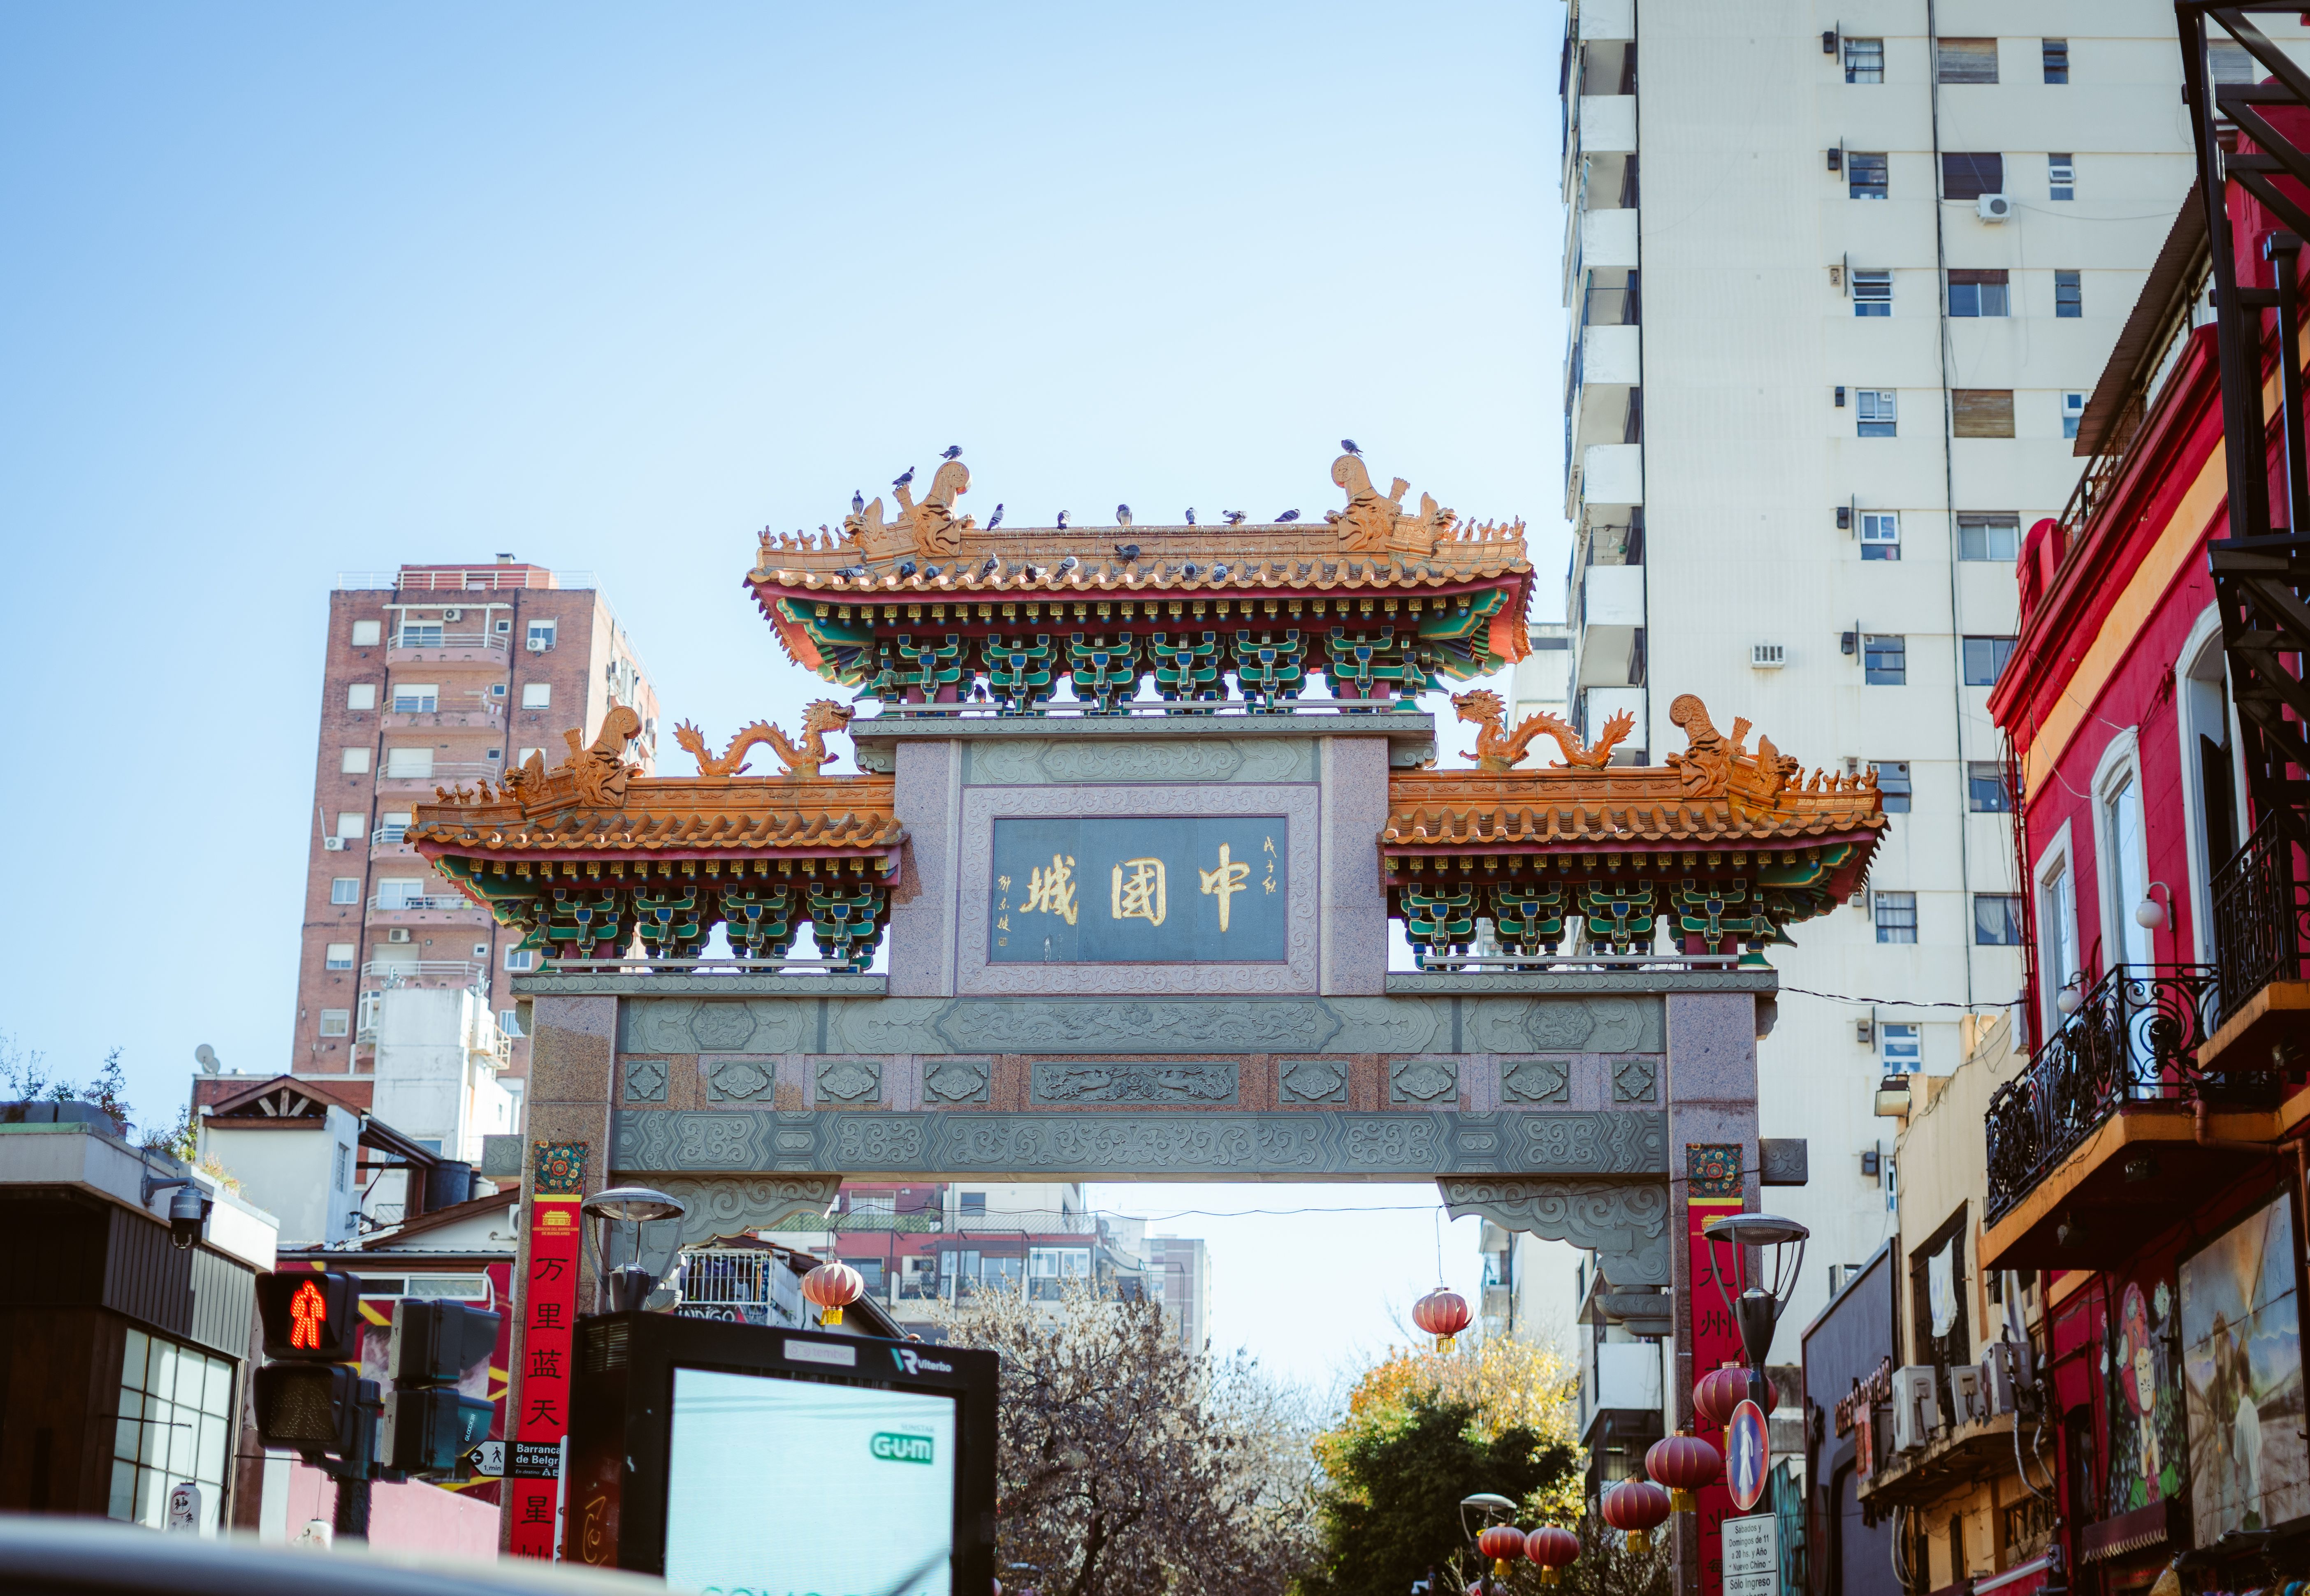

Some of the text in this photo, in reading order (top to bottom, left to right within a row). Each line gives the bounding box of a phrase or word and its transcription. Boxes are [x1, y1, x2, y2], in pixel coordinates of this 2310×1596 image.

[918, 1359, 952, 1372] Viterbo
[516, 1455, 560, 1466] de Belgr
[1735, 1524, 1762, 1534] Sábados y
[1729, 1534, 1769, 1547] Domingos de 11
[1736, 1550, 1742, 1559] 20
[1752, 1550, 1755, 1559] y
[1756, 1547, 1767, 1556] Año
[1733, 1561, 1766, 1572] Nuevo Chino
[1730, 1577, 1770, 1590] Sólo Ingreso
